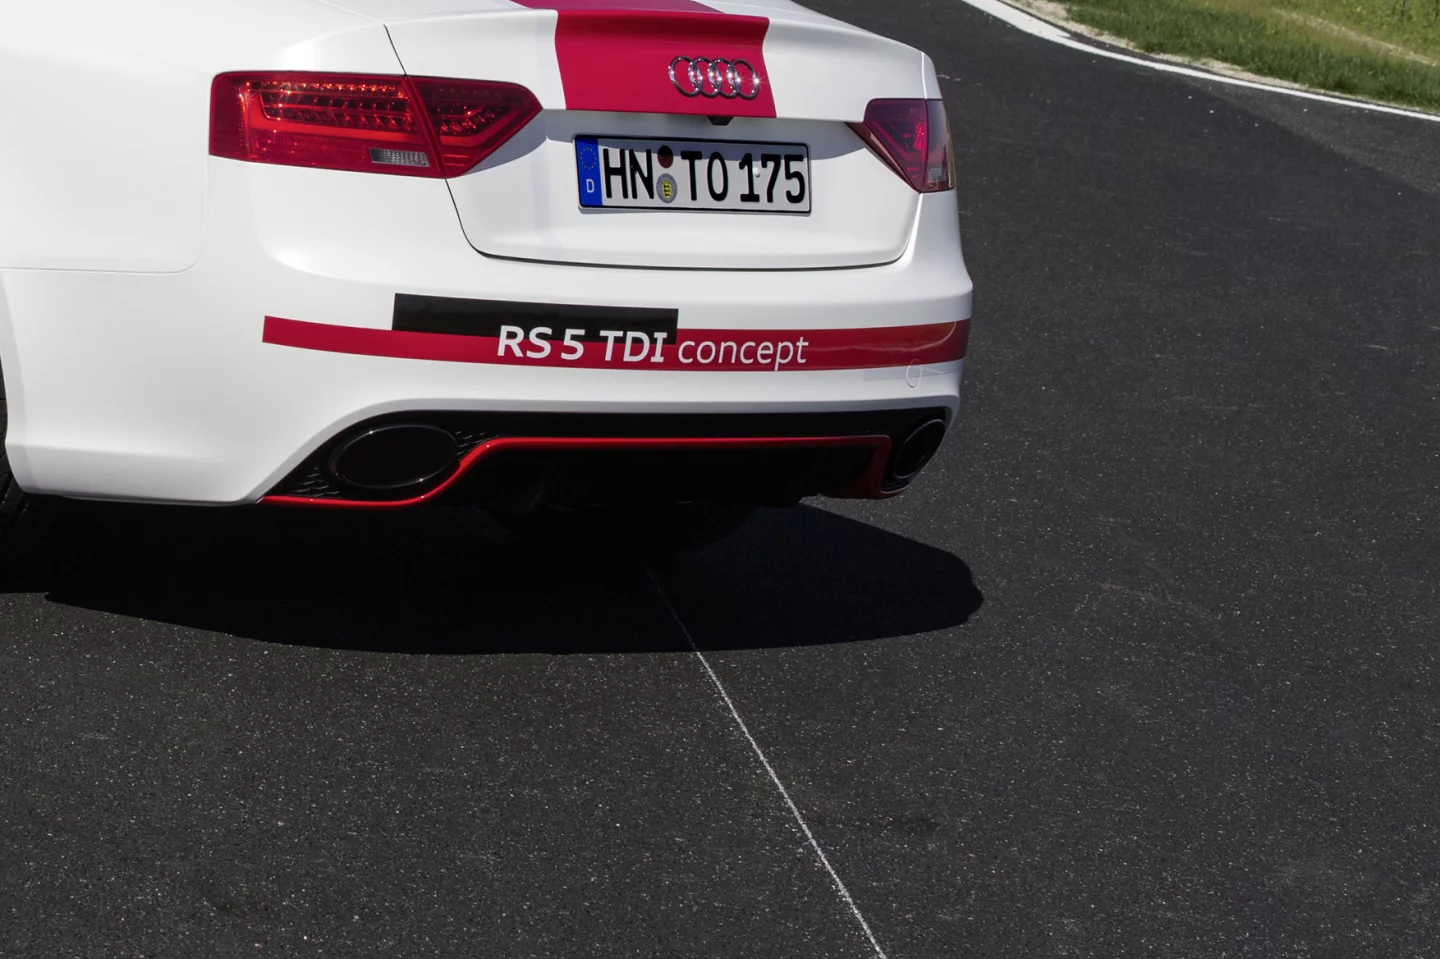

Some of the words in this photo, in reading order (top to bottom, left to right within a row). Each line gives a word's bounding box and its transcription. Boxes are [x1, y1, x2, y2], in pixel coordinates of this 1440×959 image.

[585, 178, 595, 193] D
[602, 148, 655, 199] HN
[738, 152, 806, 204] 175
[496, 325, 552, 358] RS
[560, 328, 586, 360] 5
[599, 330, 668, 363] TDI
[677, 336, 809, 372] concept
